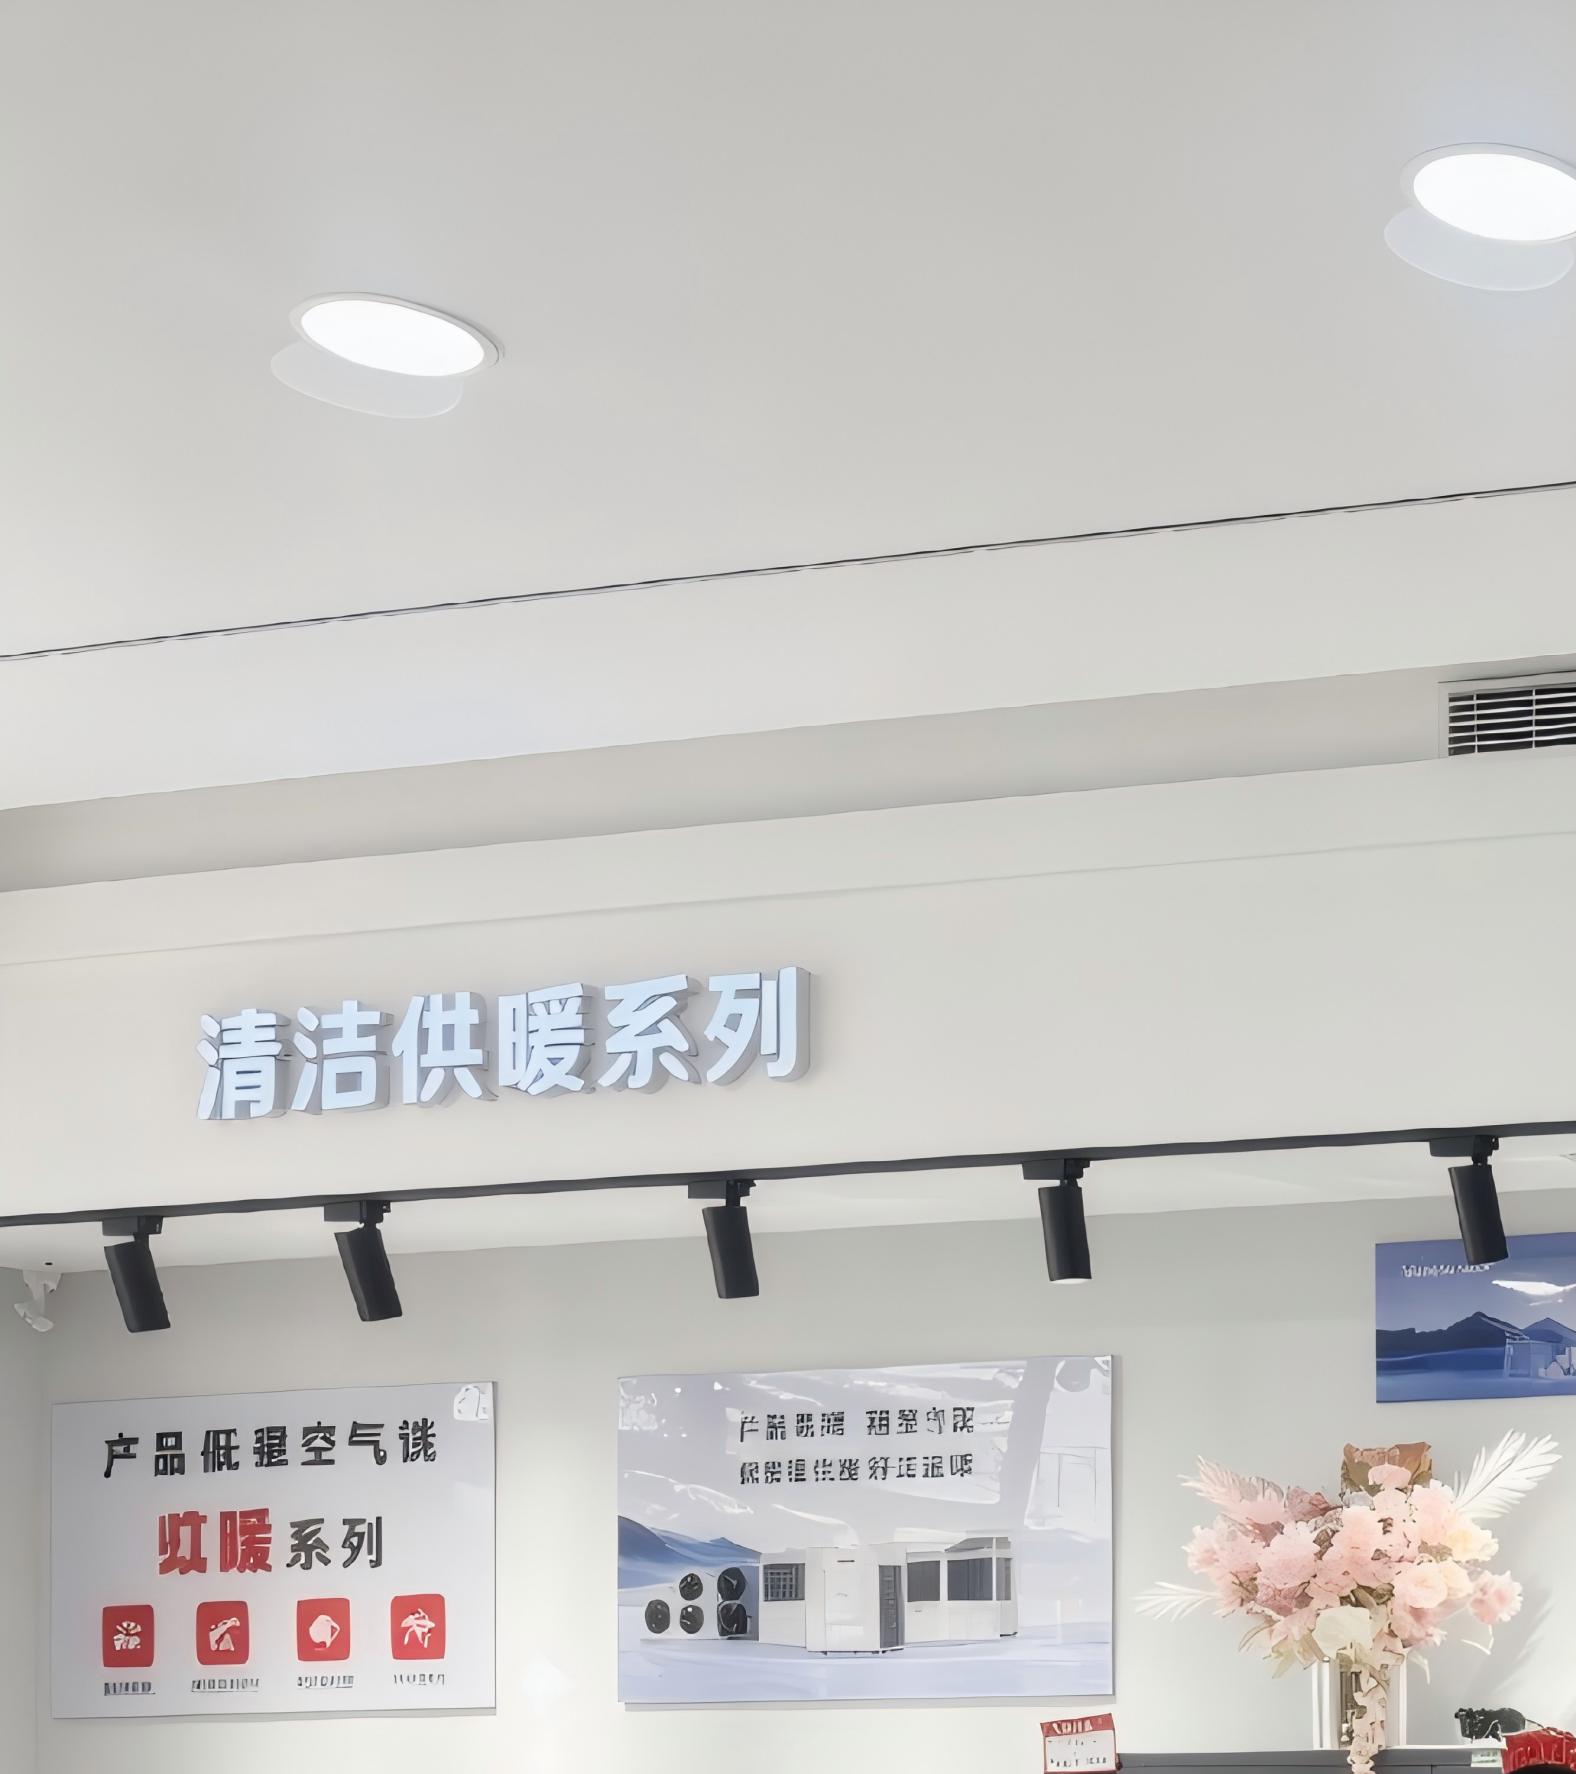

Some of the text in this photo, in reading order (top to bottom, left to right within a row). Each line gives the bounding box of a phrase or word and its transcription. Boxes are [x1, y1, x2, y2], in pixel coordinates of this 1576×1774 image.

[196, 966, 800, 1120] 清洁供暖系列
